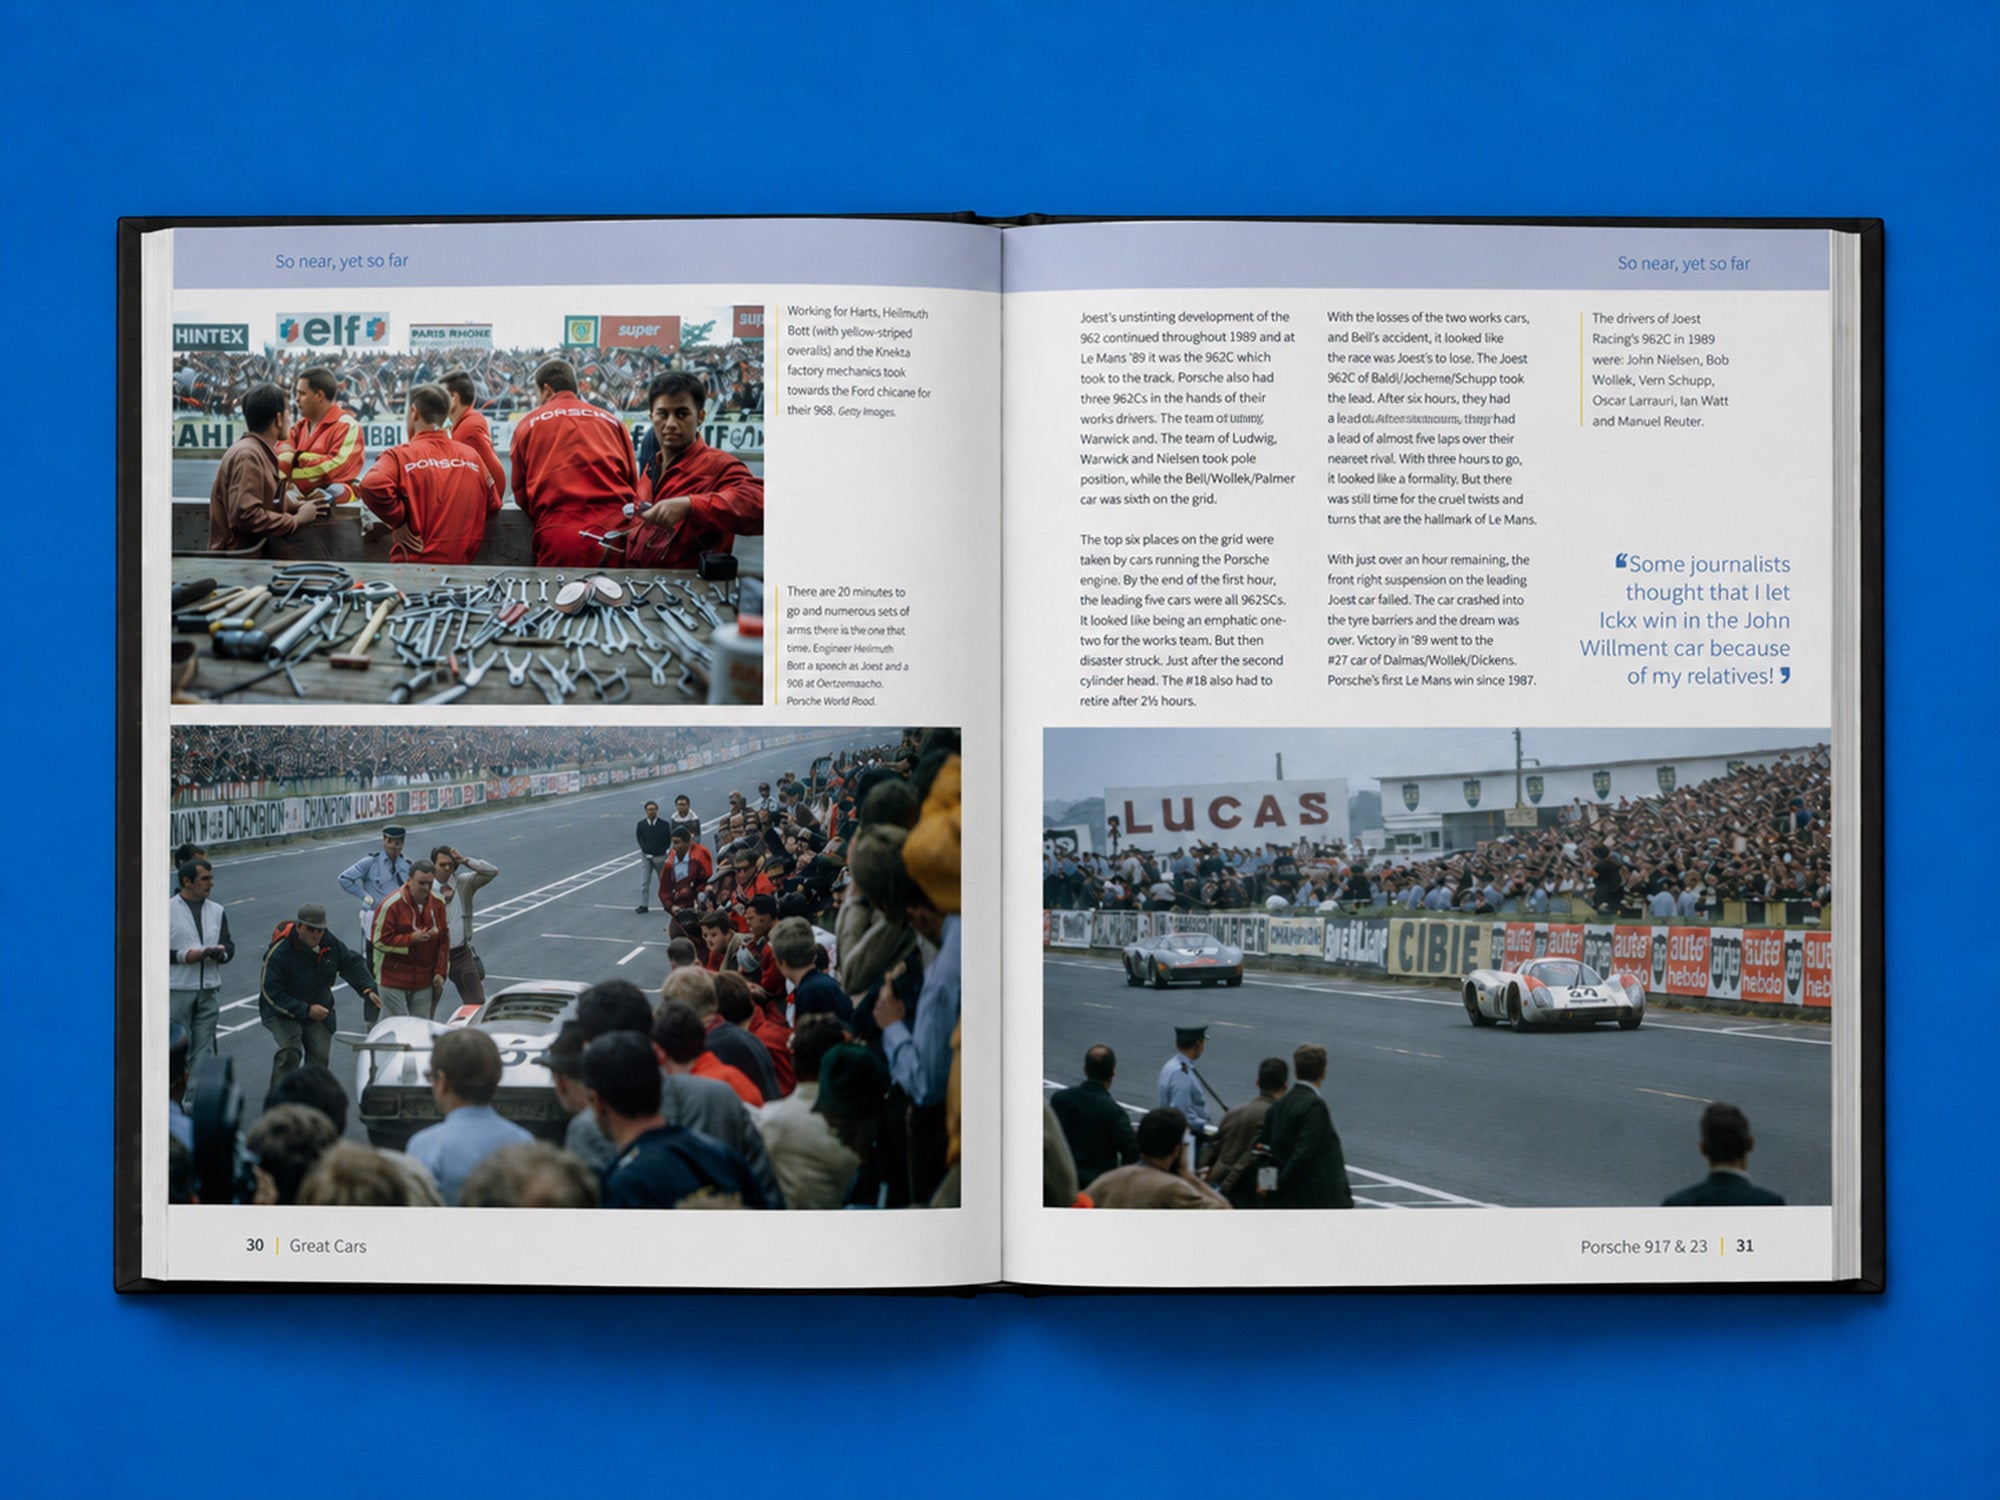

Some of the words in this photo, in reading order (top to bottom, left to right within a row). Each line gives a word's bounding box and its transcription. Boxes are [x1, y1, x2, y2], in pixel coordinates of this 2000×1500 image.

[276, 254, 295, 268] So
[299, 257, 336, 270] near,
[340, 255, 363, 272] yet
[367, 256, 385, 267] so
[389, 253, 409, 267] far
[1618, 256, 1637, 270] So
[1642, 259, 1678, 272] near,
[1683, 258, 1705, 273] yet
[1710, 260, 1727, 270] so
[1731, 256, 1751, 270] far
[787, 306, 831, 319] Working
[834, 306, 848, 317] for
[850, 307, 880, 318] Harts,
[1119, 312, 1176, 325] unstinting
[1178, 311, 1254, 324] development
[1256, 311, 1269, 322] of
[1271, 311, 1290, 322] the
[1327, 311, 1353, 322] With
[1356, 312, 1374, 322] the
[1376, 312, 1409, 323] losses
[1412, 311, 1423, 323] of
[1425, 312, 1443, 323] the
[1445, 314, 1467, 323] two
[1469, 312, 1502, 323] works
[1504, 315, 1529, 324] cars,
[1593, 313, 1614, 324] The
[1616, 313, 1655, 324] drivers
[1657, 313, 1670, 324] of
[1672, 314, 1701, 324] Joest
[175, 328, 244, 344] HINTEX
[302, 314, 360, 347] elf
[411, 329, 446, 338] PARIS
[618, 324, 661, 340] super
[788, 325, 810, 336] Bott
[812, 326, 839, 337] (with
[841, 327, 912, 340] yellow-striped
[1080, 333, 1100, 344] 962
[1103, 332, 1159, 343] continued
[1162, 331, 1226, 345] throughout
[1230, 331, 1257, 342] 1989
[1259, 331, 1281, 342] and
[1284, 333, 1295, 342] at
[1642, 333, 1671, 344] 962C
[1674, 334, 1684, 344] in
[1689, 334, 1715, 344] 1989
[834, 346, 854, 356] and
[856, 346, 874, 357] the
[1592, 356, 1624, 365] were:
[1627, 354, 1654, 365] John
[1657, 355, 1703, 366] Nielsen,
[1706, 354, 1729, 365] Bob
[788, 364, 824, 378] factory
[826, 366, 882, 377] mechanics
[883, 367, 906, 377] took
[1668, 375, 1715, 388] Schupp,
[787, 385, 830, 396] towards
[832, 385, 849, 396] the
[851, 386, 875, 397] Ford
[877, 387, 916, 398] chicane
[918, 388, 931, 398] for
[1592, 395, 1626, 406] Oscar
[1680, 396, 1698, 406] Ian
[1701, 395, 1728, 406] Watt
[787, 405, 811, 415] their
[814, 405, 835, 416] 968.
[1593, 416, 1615, 427] and
[1618, 416, 1661, 427] Manuel
[1664, 416, 1704, 427] Reuter.
[1080, 453, 1129, 465] Warwick
[1131, 453, 1154, 464] and
[1157, 453, 1199, 464] Nielsen
[1202, 453, 1228, 464] took
[1231, 453, 1256, 466] pole
[1691, 555, 1790, 577] journalists
[788, 586, 817, 597] There
[819, 589, 836, 597] are
[838, 586, 851, 597] 20
[853, 587, 893, 597] minutes
[895, 589, 906, 597] to
[1626, 583, 1704, 605] thought
[1710, 583, 1749, 601] that
[1756, 585, 1759, 600] I
[1766, 583, 1790, 601] let
[787, 608, 800, 619] go
[802, 606, 822, 616] and
[825, 608, 876, 616] numerous
[878, 608, 898, 616] sets
[899, 606, 910, 616] of
[1600, 611, 1637, 629] Ickx
[1643, 612, 1677, 628] win
[1684, 612, 1700, 628] in
[1707, 611, 1738, 629] the
[1744, 611, 1789, 629] John
[1580, 639, 1668, 656] Willment
[1674, 644, 1704, 656] car
[1710, 639, 1790, 657] because
[1382, 674, 1403, 686] first
[1406, 675, 1419, 686] Le
[1421, 675, 1452, 686] Mans
[1454, 675, 1474, 685] win
[1476, 675, 1505, 686] since
[1509, 675, 1536, 686] 1987.
[1628, 666, 1647, 685] of
[1653, 671, 1682, 689] my
[1080, 695, 1109, 707] retire
[1112, 695, 1138, 706] after
[1161, 695, 1196, 706] hours.
[1124, 791, 1330, 835] LUCAS
[1398, 921, 1481, 974] CIBIE
[1667, 966, 1707, 988] hebdo
[1742, 970, 1782, 995] hebdo
[247, 1238, 264, 1251] 30
[290, 1239, 330, 1253] Great
[334, 1239, 366, 1253] Cars
[1582, 1240, 1640, 1254] Porsche
[1645, 1240, 1671, 1253] 917
[1675, 1240, 1686, 1253] &
[1690, 1240, 1707, 1253] 23
[1736, 1239, 1754, 1252] 31
